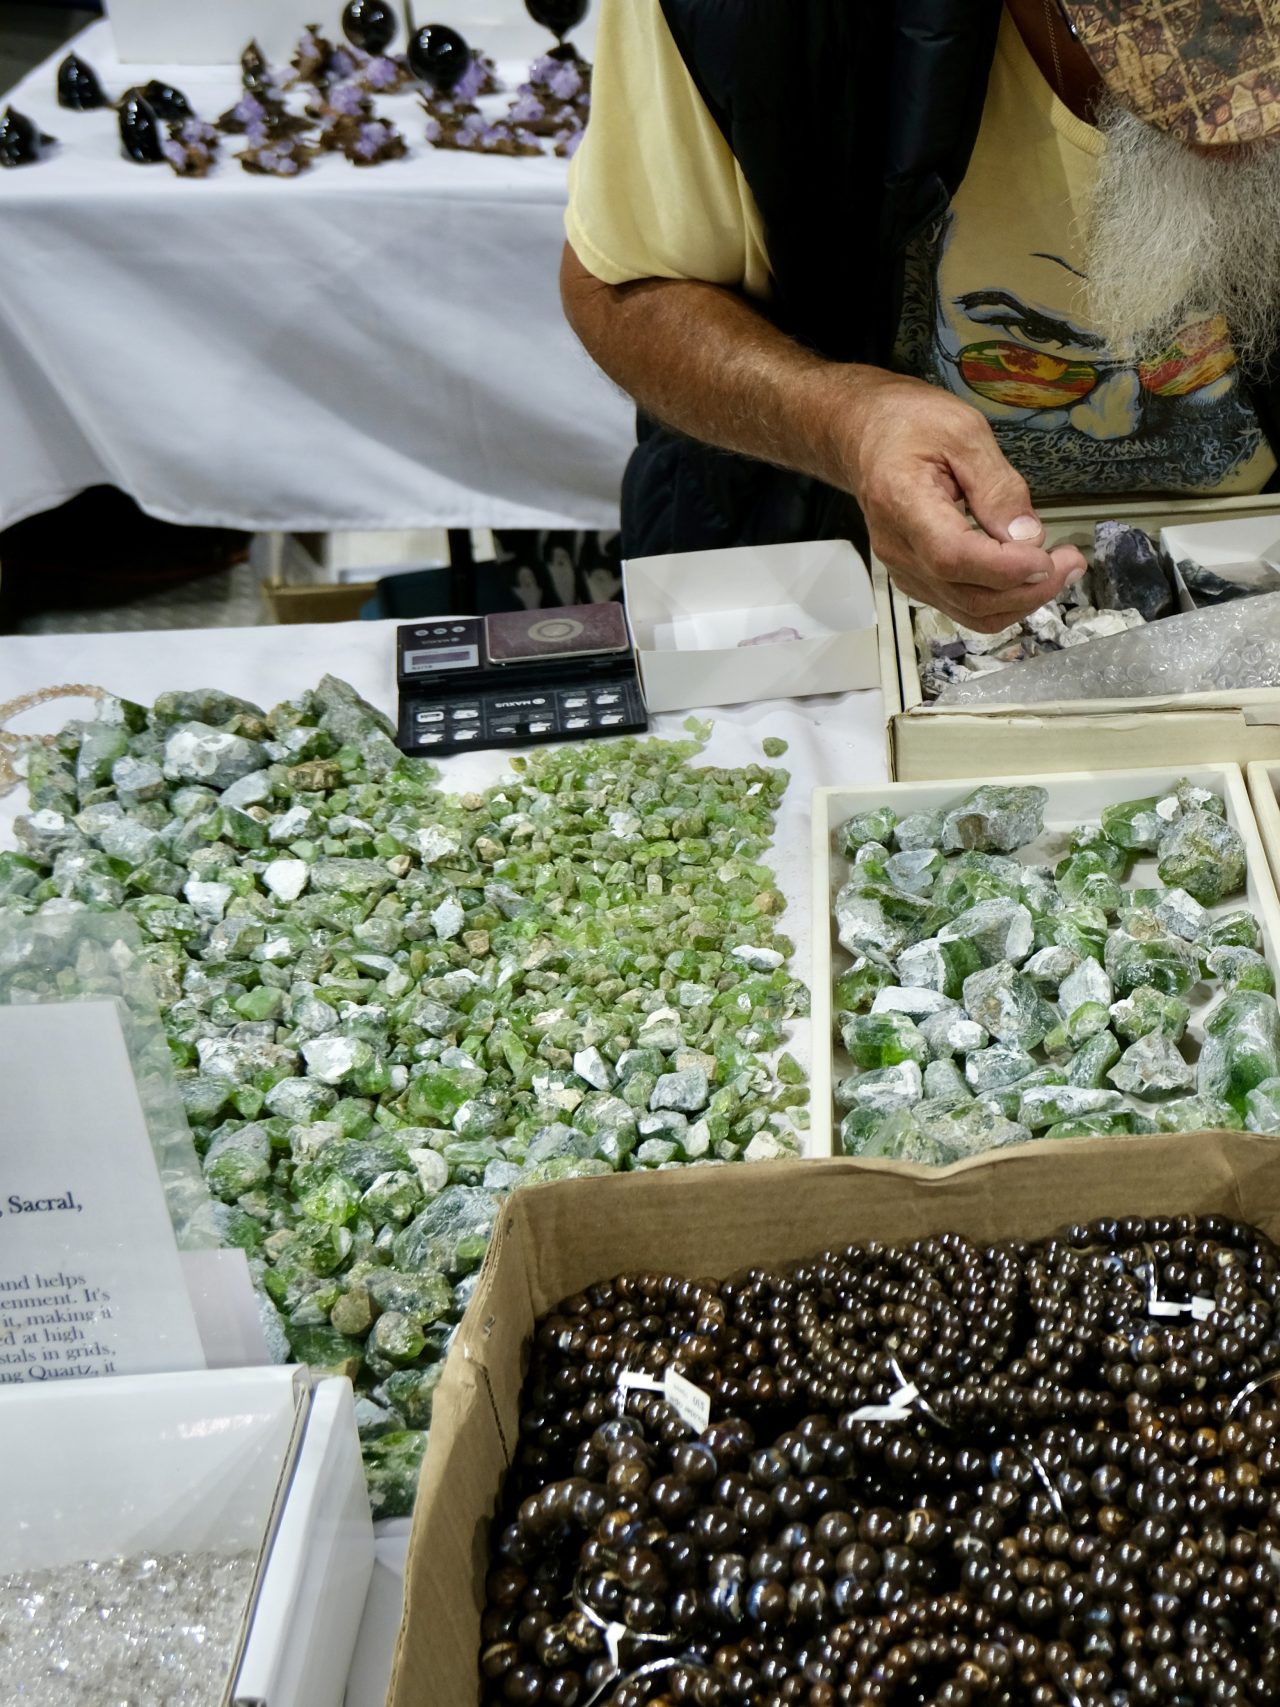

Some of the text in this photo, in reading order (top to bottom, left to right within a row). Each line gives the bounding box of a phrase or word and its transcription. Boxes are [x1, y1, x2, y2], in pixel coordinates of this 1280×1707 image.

[494, 699, 531, 708] MAXUS
[8, 1191, 83, 1214] Sacral,
[36, 1272, 87, 1289] helps
[84, 1288, 111, 1302] It's
[2, 1305, 112, 1328] it, making it
[23, 1332, 38, 1344] at
[44, 1325, 85, 1343] high
[42, 1346, 60, 1361] in
[66, 1341, 116, 1361] grids,
[28, 1364, 99, 1380] Quartz,
[104, 1358, 116, 1373] it
